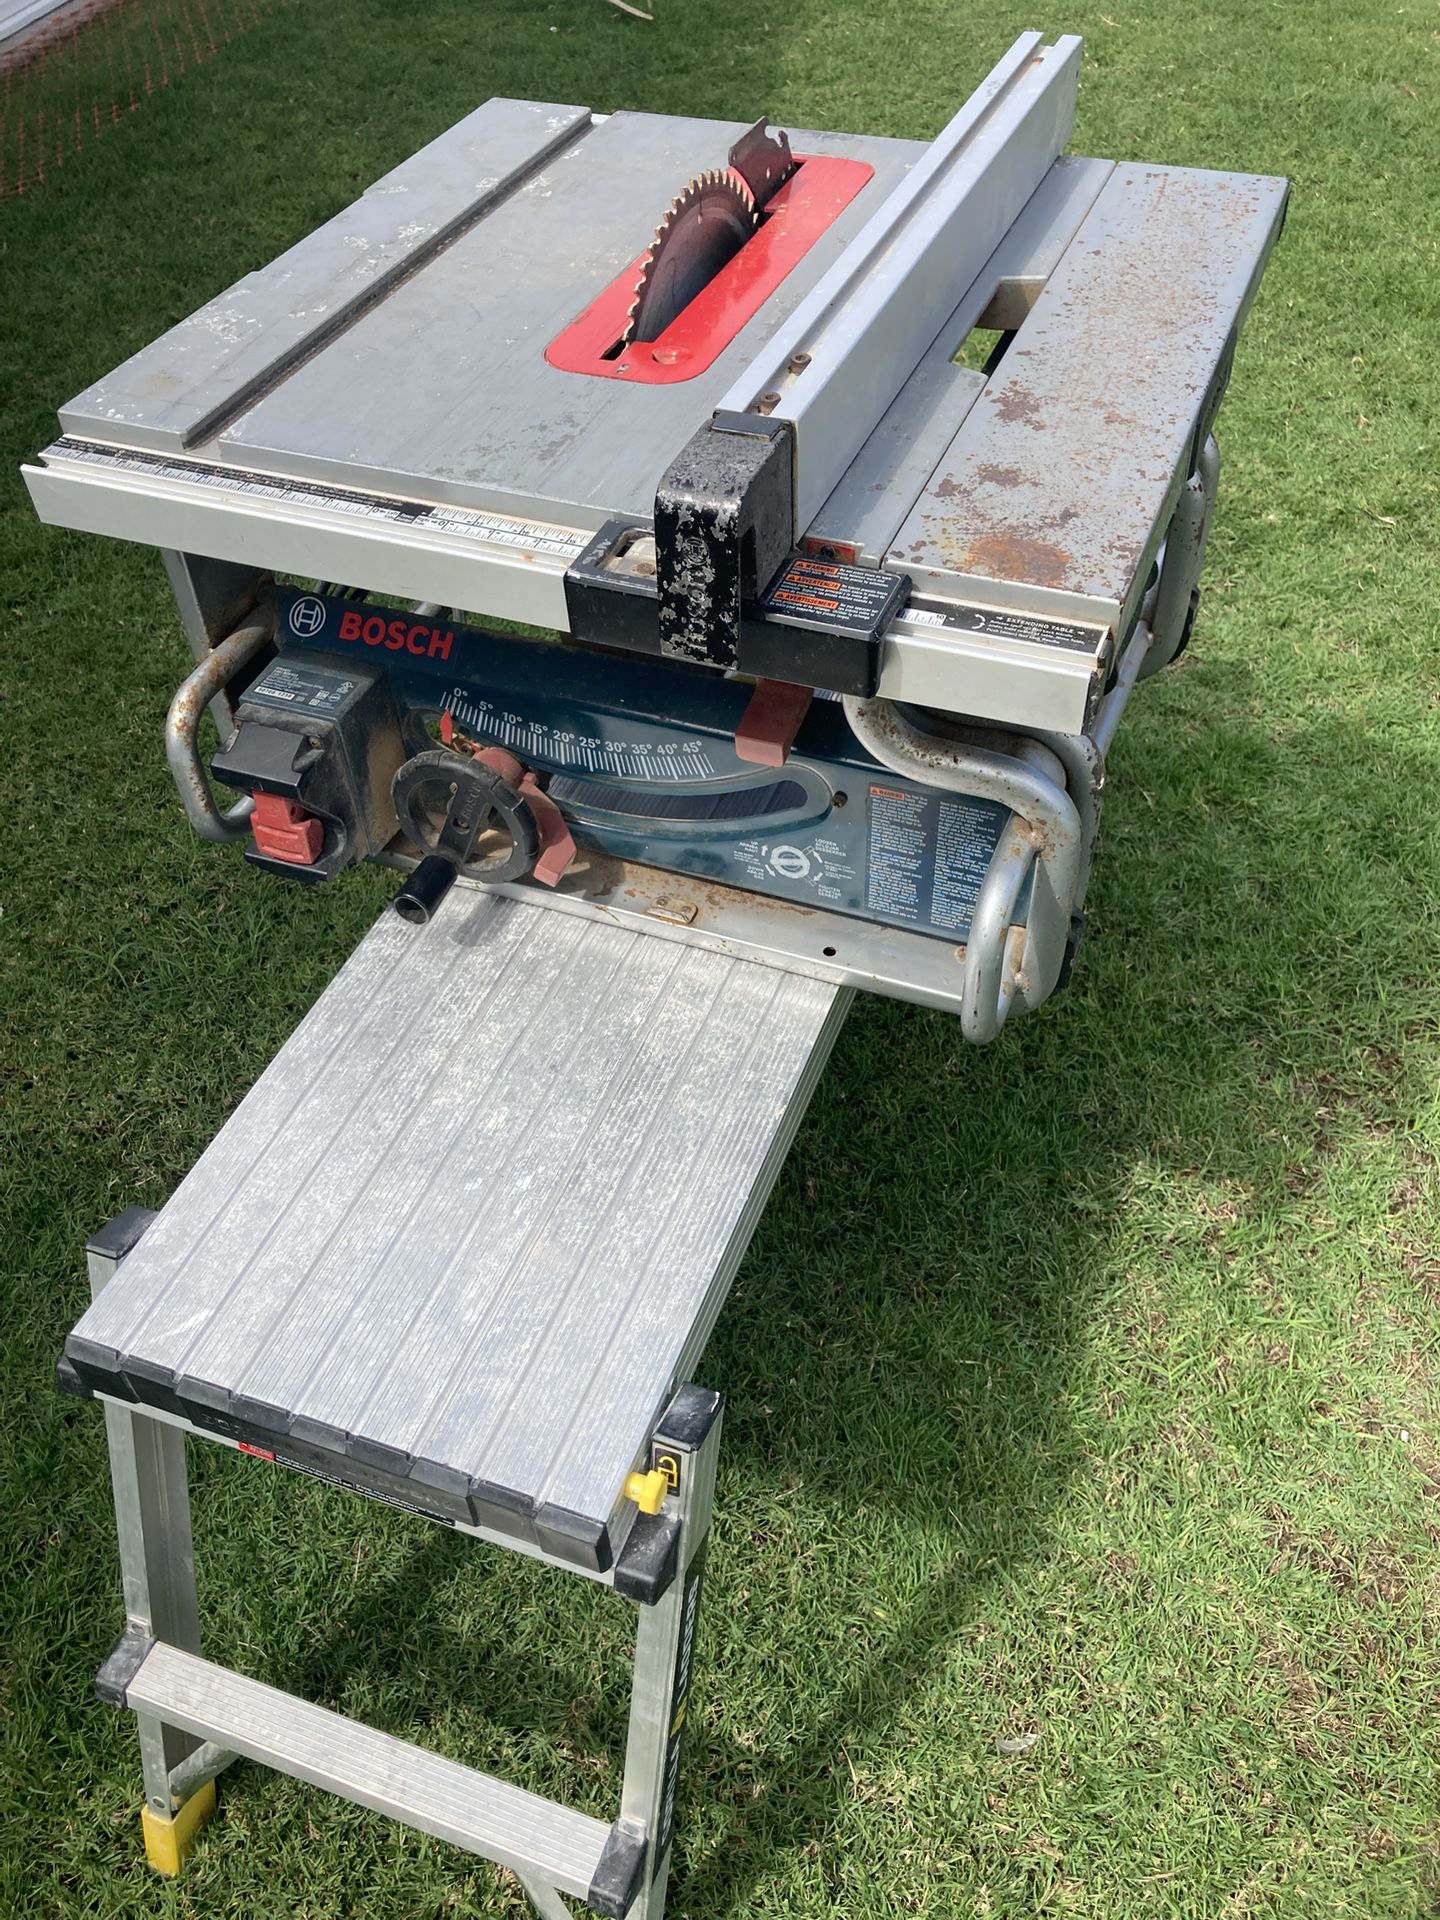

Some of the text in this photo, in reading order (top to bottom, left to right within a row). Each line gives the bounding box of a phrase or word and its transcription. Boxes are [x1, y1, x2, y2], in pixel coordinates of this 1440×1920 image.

[806, 562, 836, 574] WARNING
[784, 593, 837, 608] AVERTISSEMENT
[338, 611, 454, 660] BOSCH
[1006, 617, 1049, 630] EXTENDING
[1051, 625, 1075, 634] TABLE
[453, 687, 703, 755] 0° 5° 10° 15° 20° 25° 30° 35° 40° 45°
[661, 1575, 700, 1847] GORILLA LADDERS
